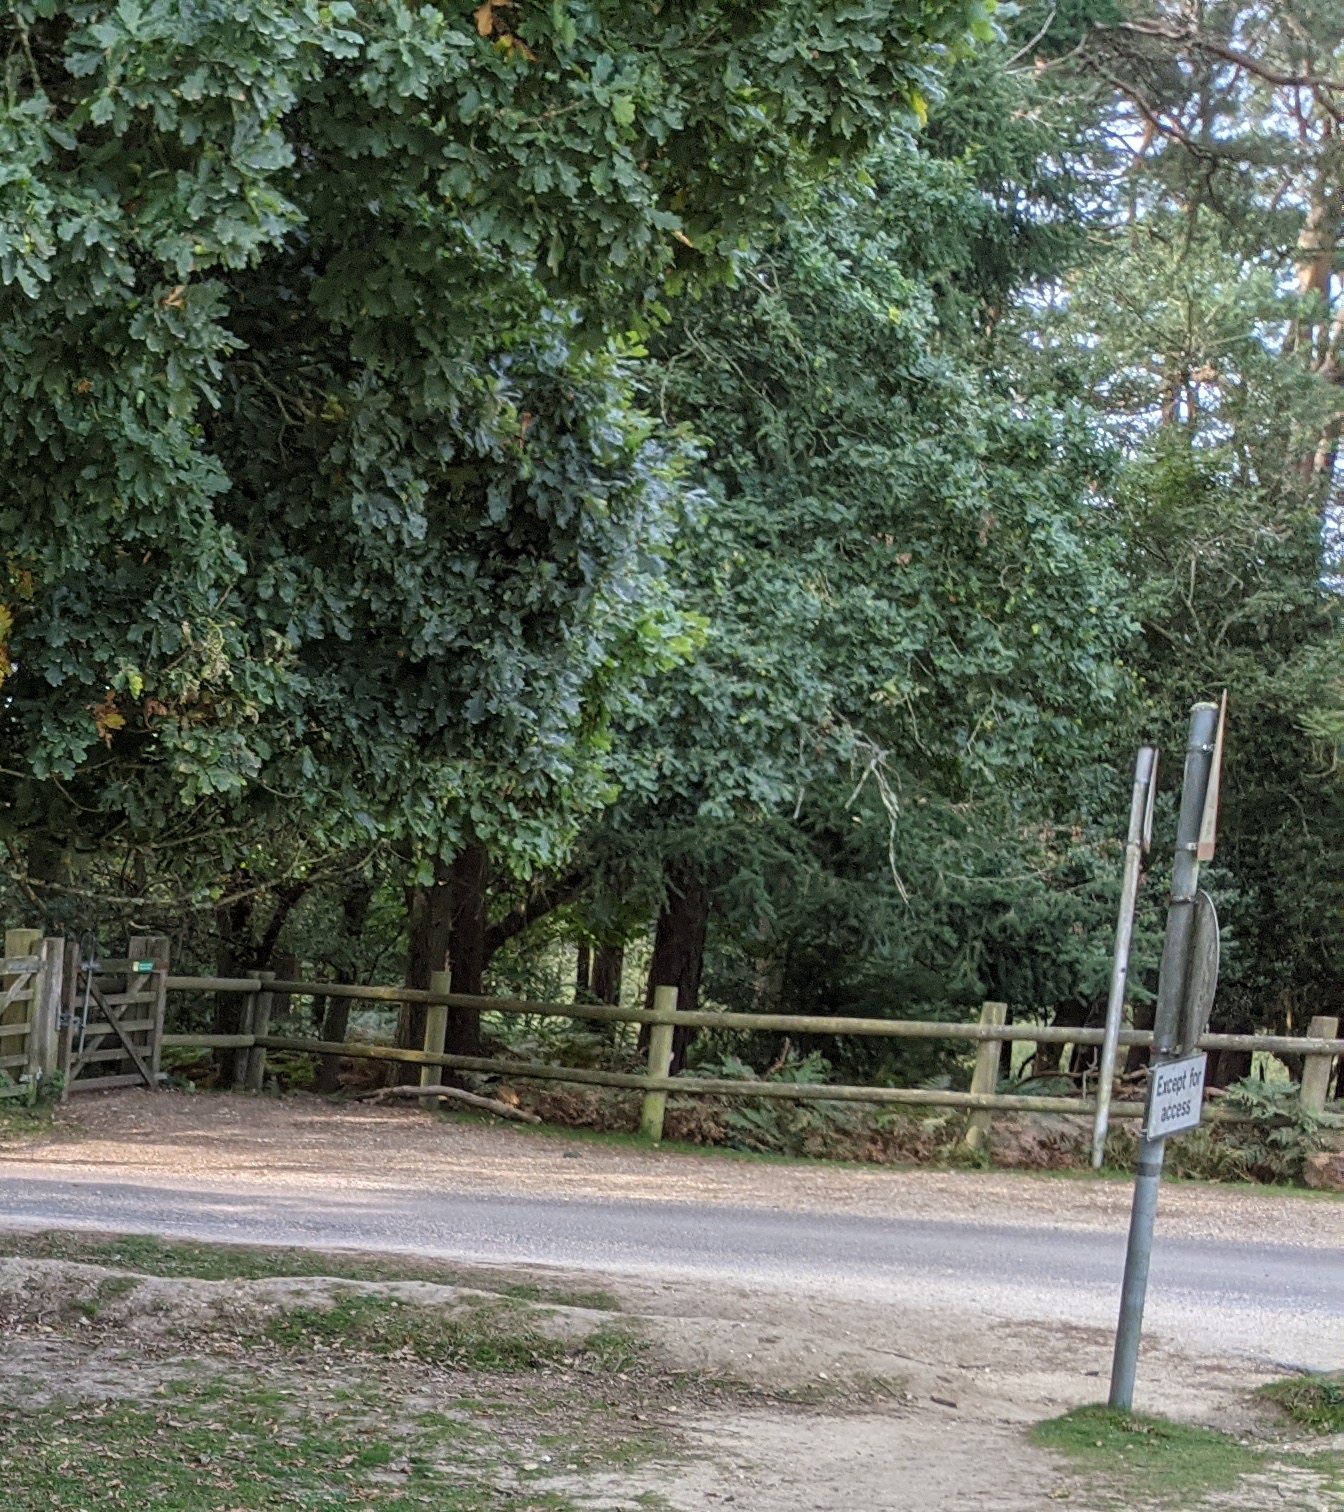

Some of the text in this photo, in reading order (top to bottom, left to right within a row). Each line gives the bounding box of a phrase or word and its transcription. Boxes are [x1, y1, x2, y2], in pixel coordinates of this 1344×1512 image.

[1156, 1067, 1202, 1096] Except for
[1161, 1099, 1191, 1122] access
